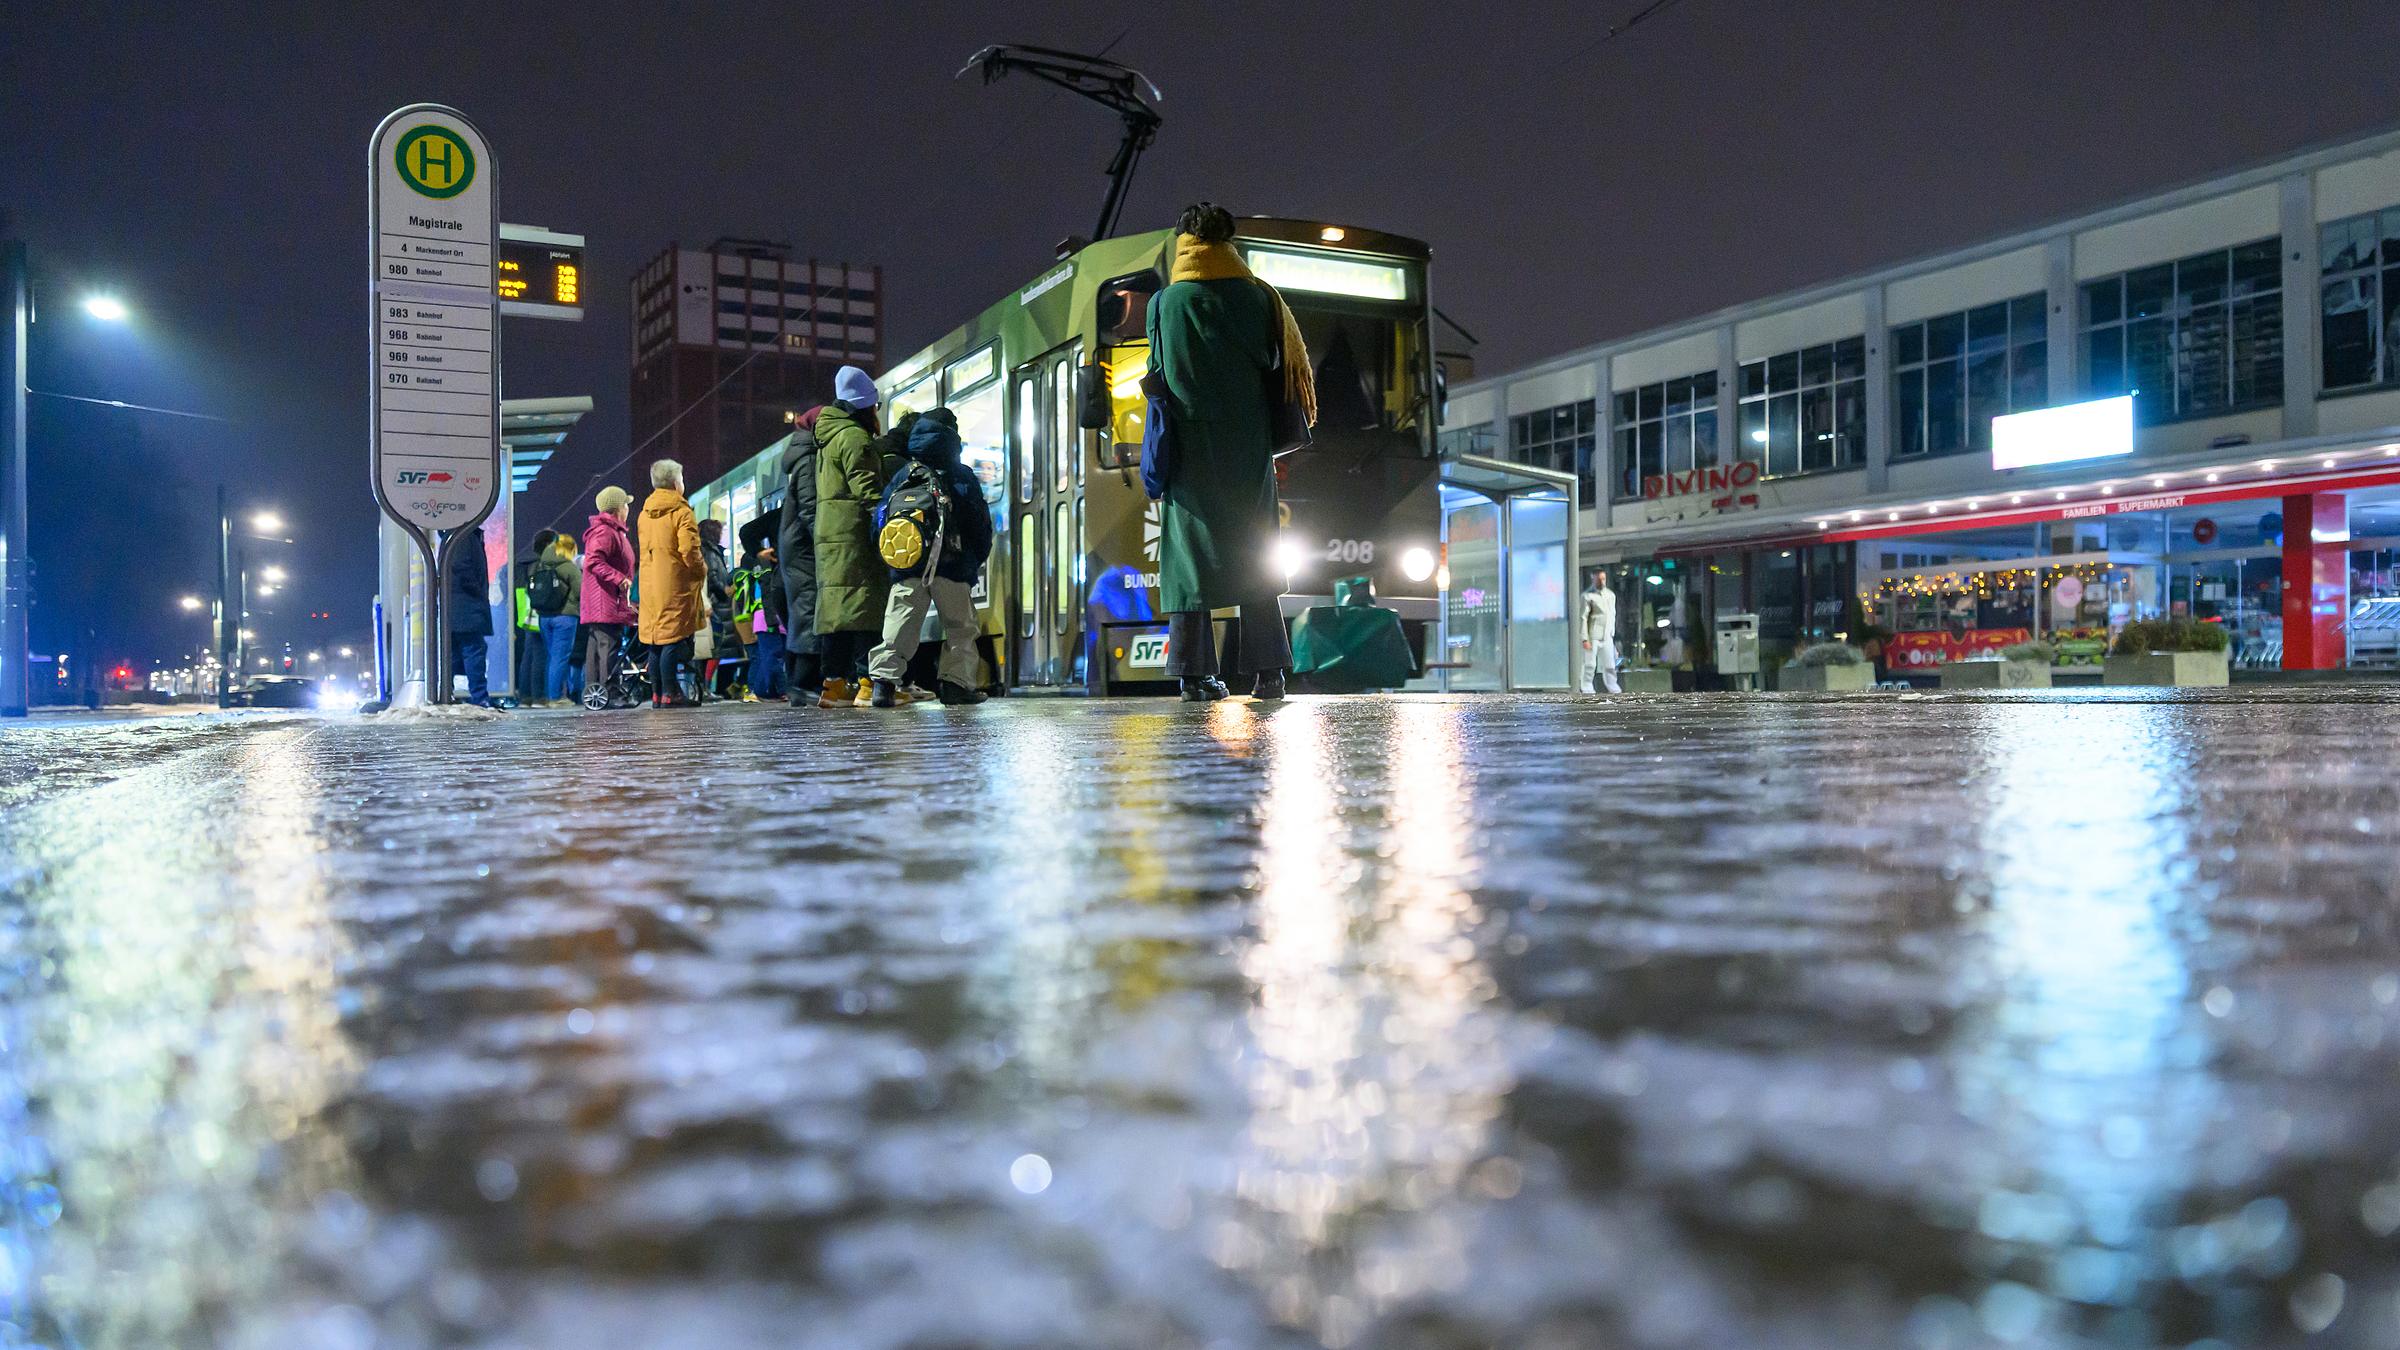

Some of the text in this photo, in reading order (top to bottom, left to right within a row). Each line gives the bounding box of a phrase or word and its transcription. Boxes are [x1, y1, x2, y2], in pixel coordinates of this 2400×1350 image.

[419, 140, 452, 183] H
[409, 215, 463, 231] Magistrale
[401, 243, 408, 253] 4
[416, 246, 452, 256] Markendorf
[389, 264, 442, 276] 980 Bahnhof
[389, 307, 443, 320] 983 Bahnhof
[389, 329, 443, 342] 968 Bahnhof
[389, 351, 443, 363] 969 Bahnhof
[388, 373, 443, 385] 970 Bahnhof
[397, 471, 428, 484] SVF
[1644, 461, 1759, 499] DIVINO
[2062, 496, 2186, 519] FAMILIEN SUPERMARKT
[1326, 538, 1375, 564] 208
[1134, 641, 1163, 661] SVF
